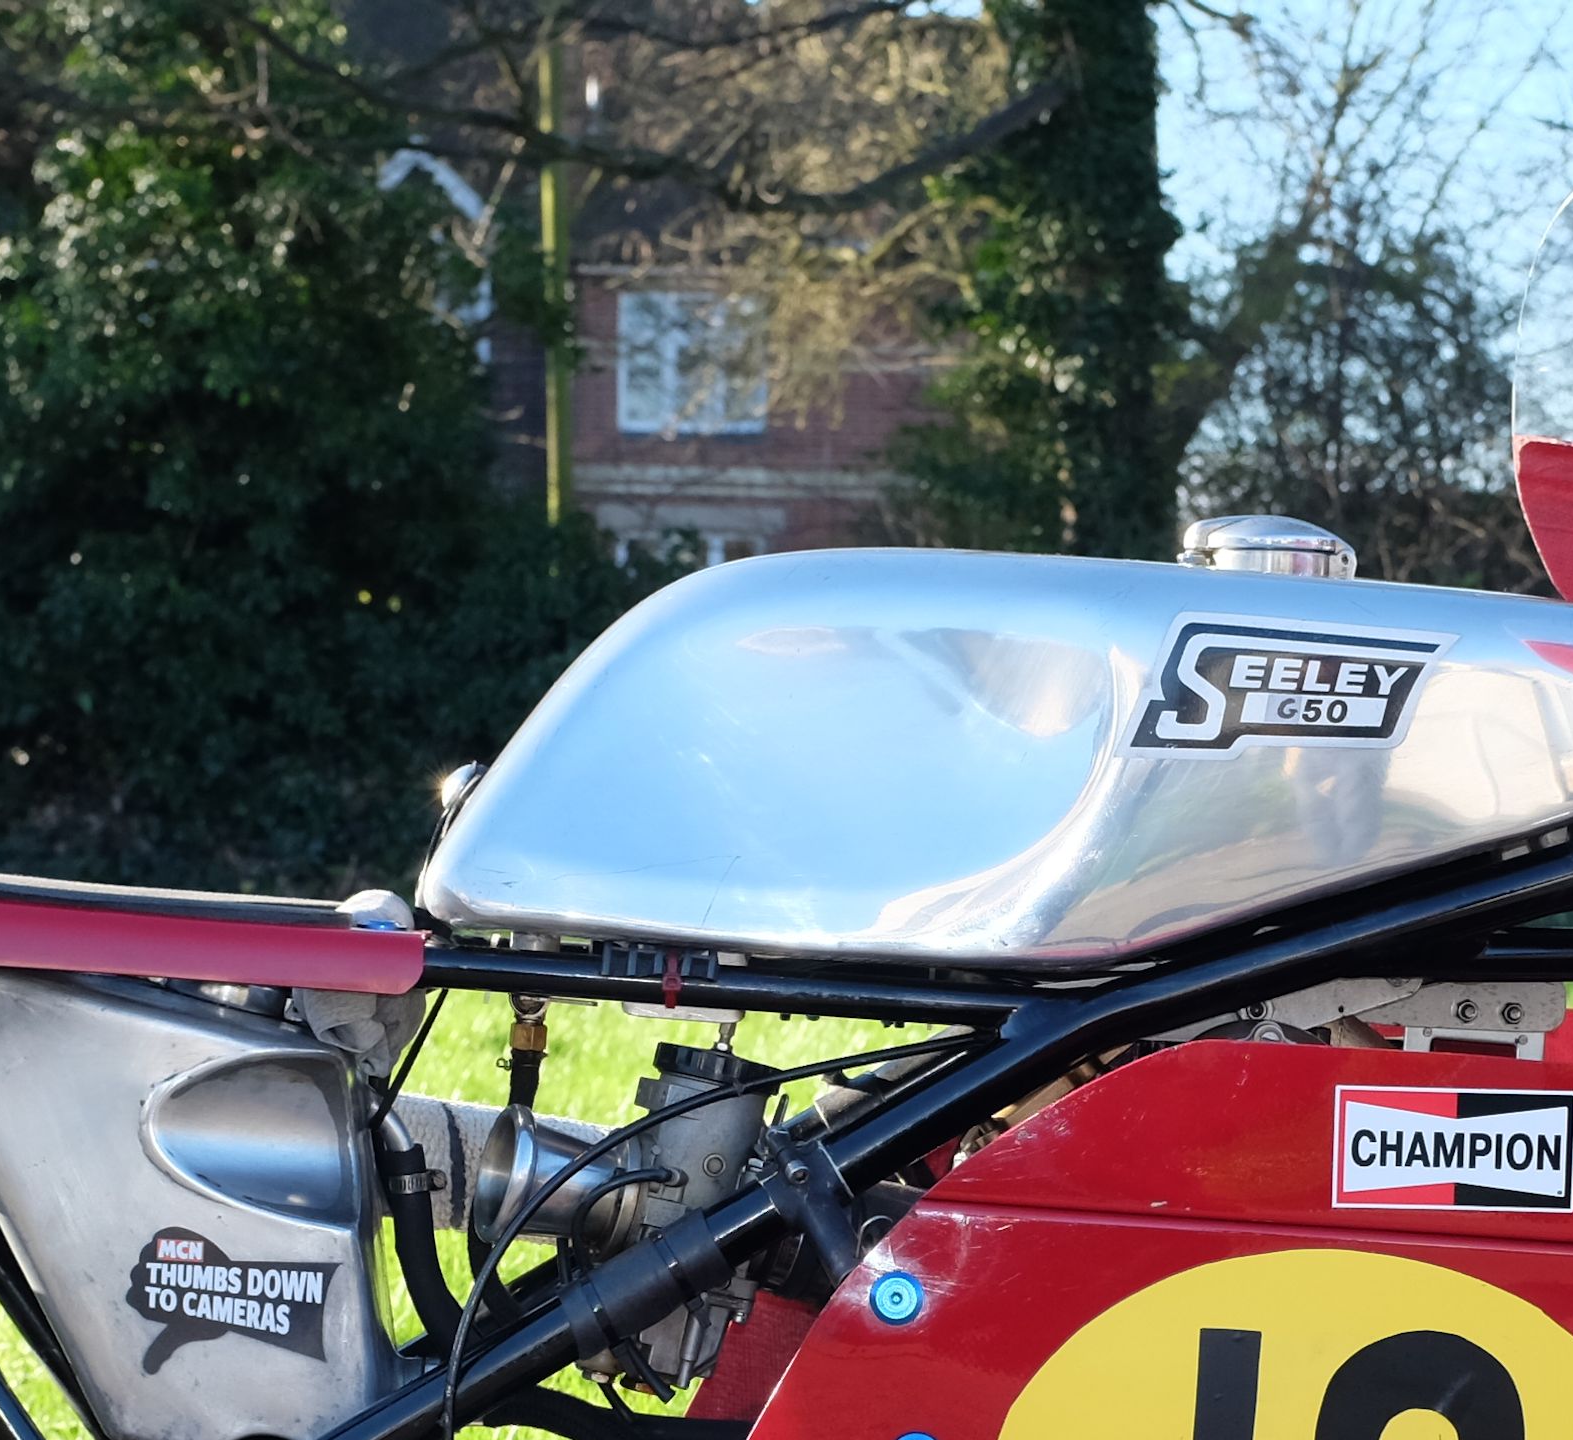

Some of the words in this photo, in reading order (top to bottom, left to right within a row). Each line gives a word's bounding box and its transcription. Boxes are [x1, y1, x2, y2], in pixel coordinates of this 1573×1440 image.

[1156, 632, 1429, 741] SEELEY
[1277, 697, 1349, 724] G50
[1351, 1129, 1561, 1171] CHAMPION
[157, 1239, 204, 1260] MCN
[146, 1262, 242, 1295] THUMBS
[247, 1267, 324, 1304] DOWN
[144, 1286, 178, 1313] TO
[182, 1292, 290, 1335] CAMERAS
